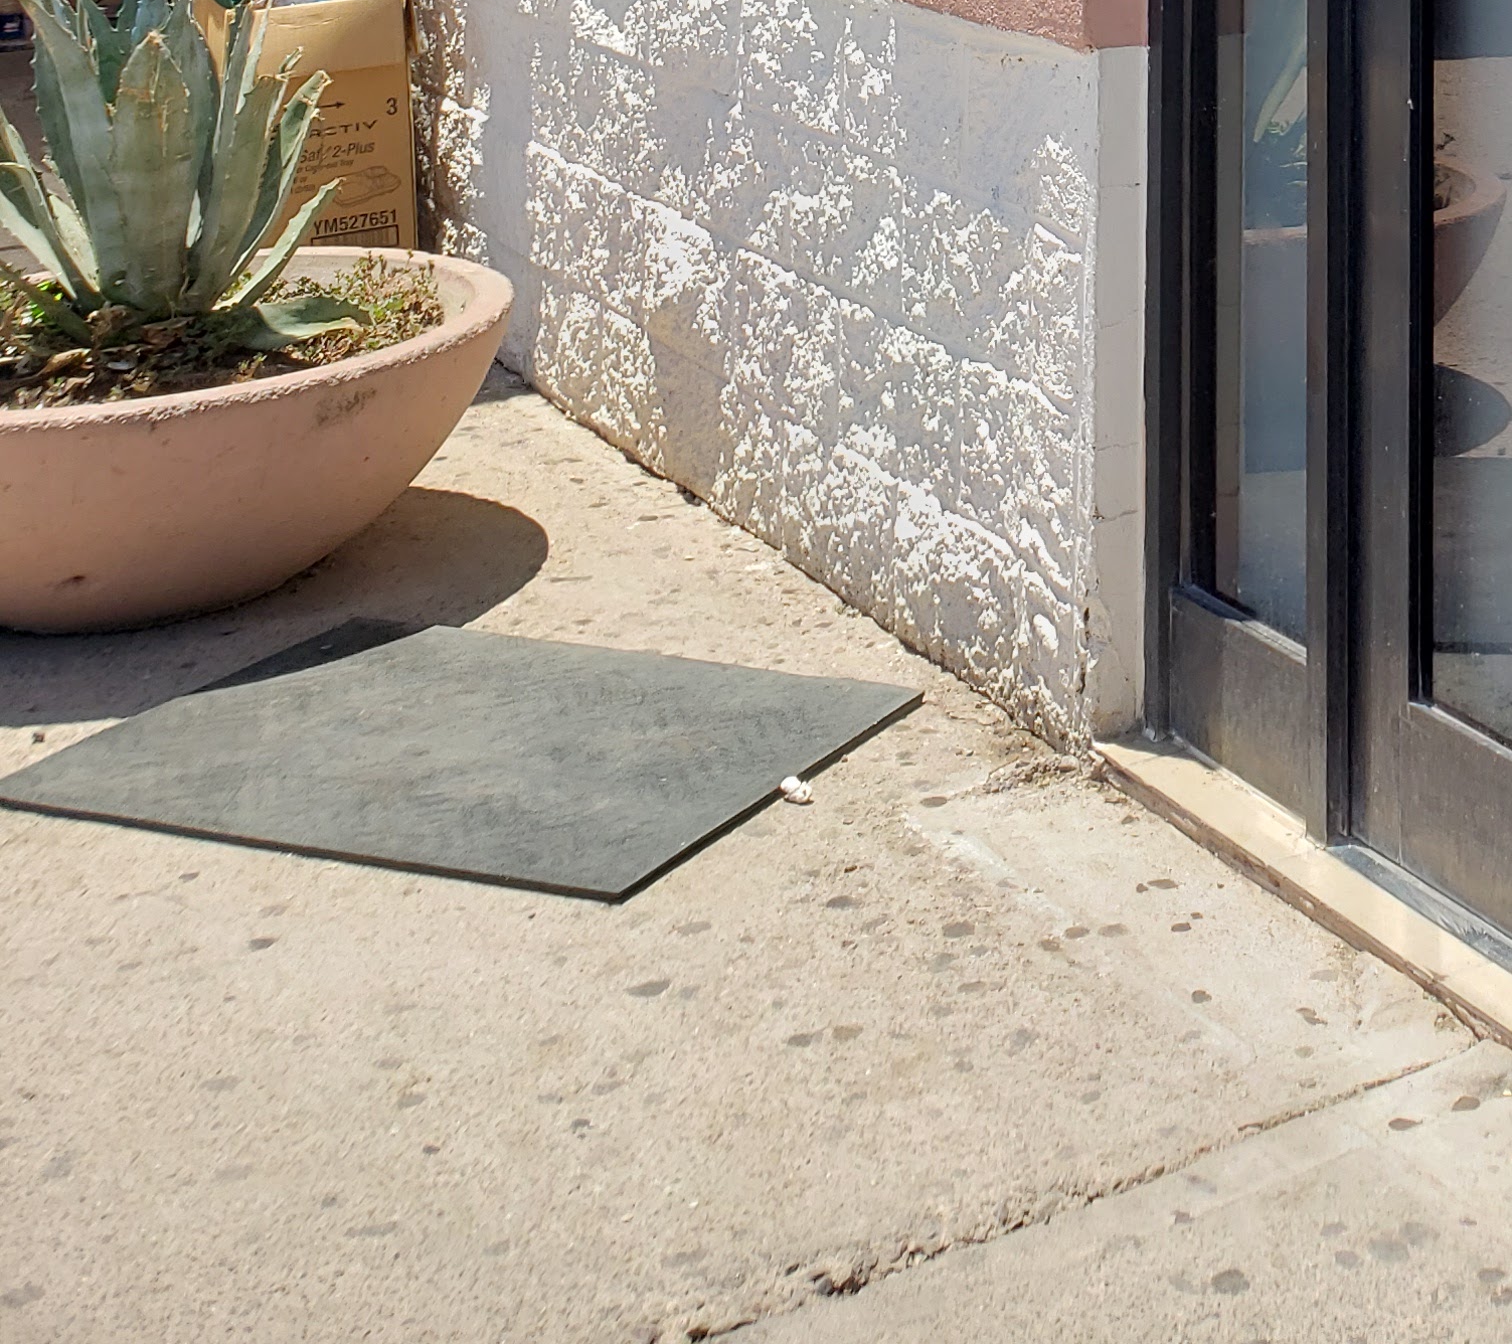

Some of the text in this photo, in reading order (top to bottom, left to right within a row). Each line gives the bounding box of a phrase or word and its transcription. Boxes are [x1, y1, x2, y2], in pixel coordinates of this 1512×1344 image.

[386, 97, 398, 115] 3
[308, 120, 378, 138] ACTIV
[313, 209, 397, 235] YM527651
